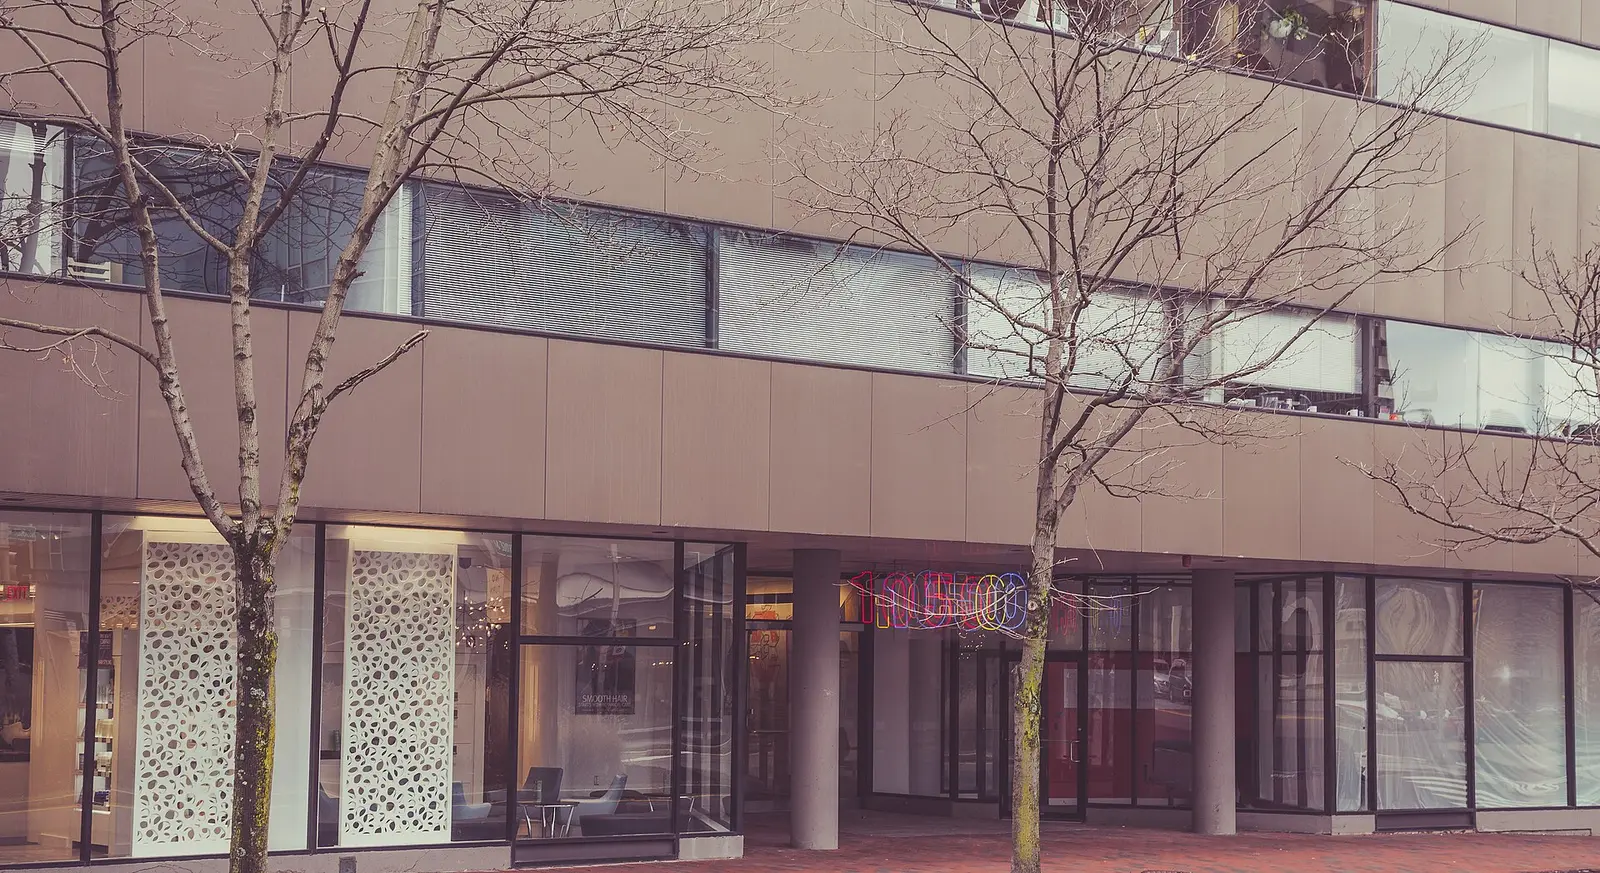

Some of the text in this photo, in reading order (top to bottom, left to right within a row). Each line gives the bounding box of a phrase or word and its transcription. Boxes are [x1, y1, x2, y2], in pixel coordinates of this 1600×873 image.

[7, 585, 28, 601] EXIT
[582, 694, 628, 703] SMOOTH HAIR
